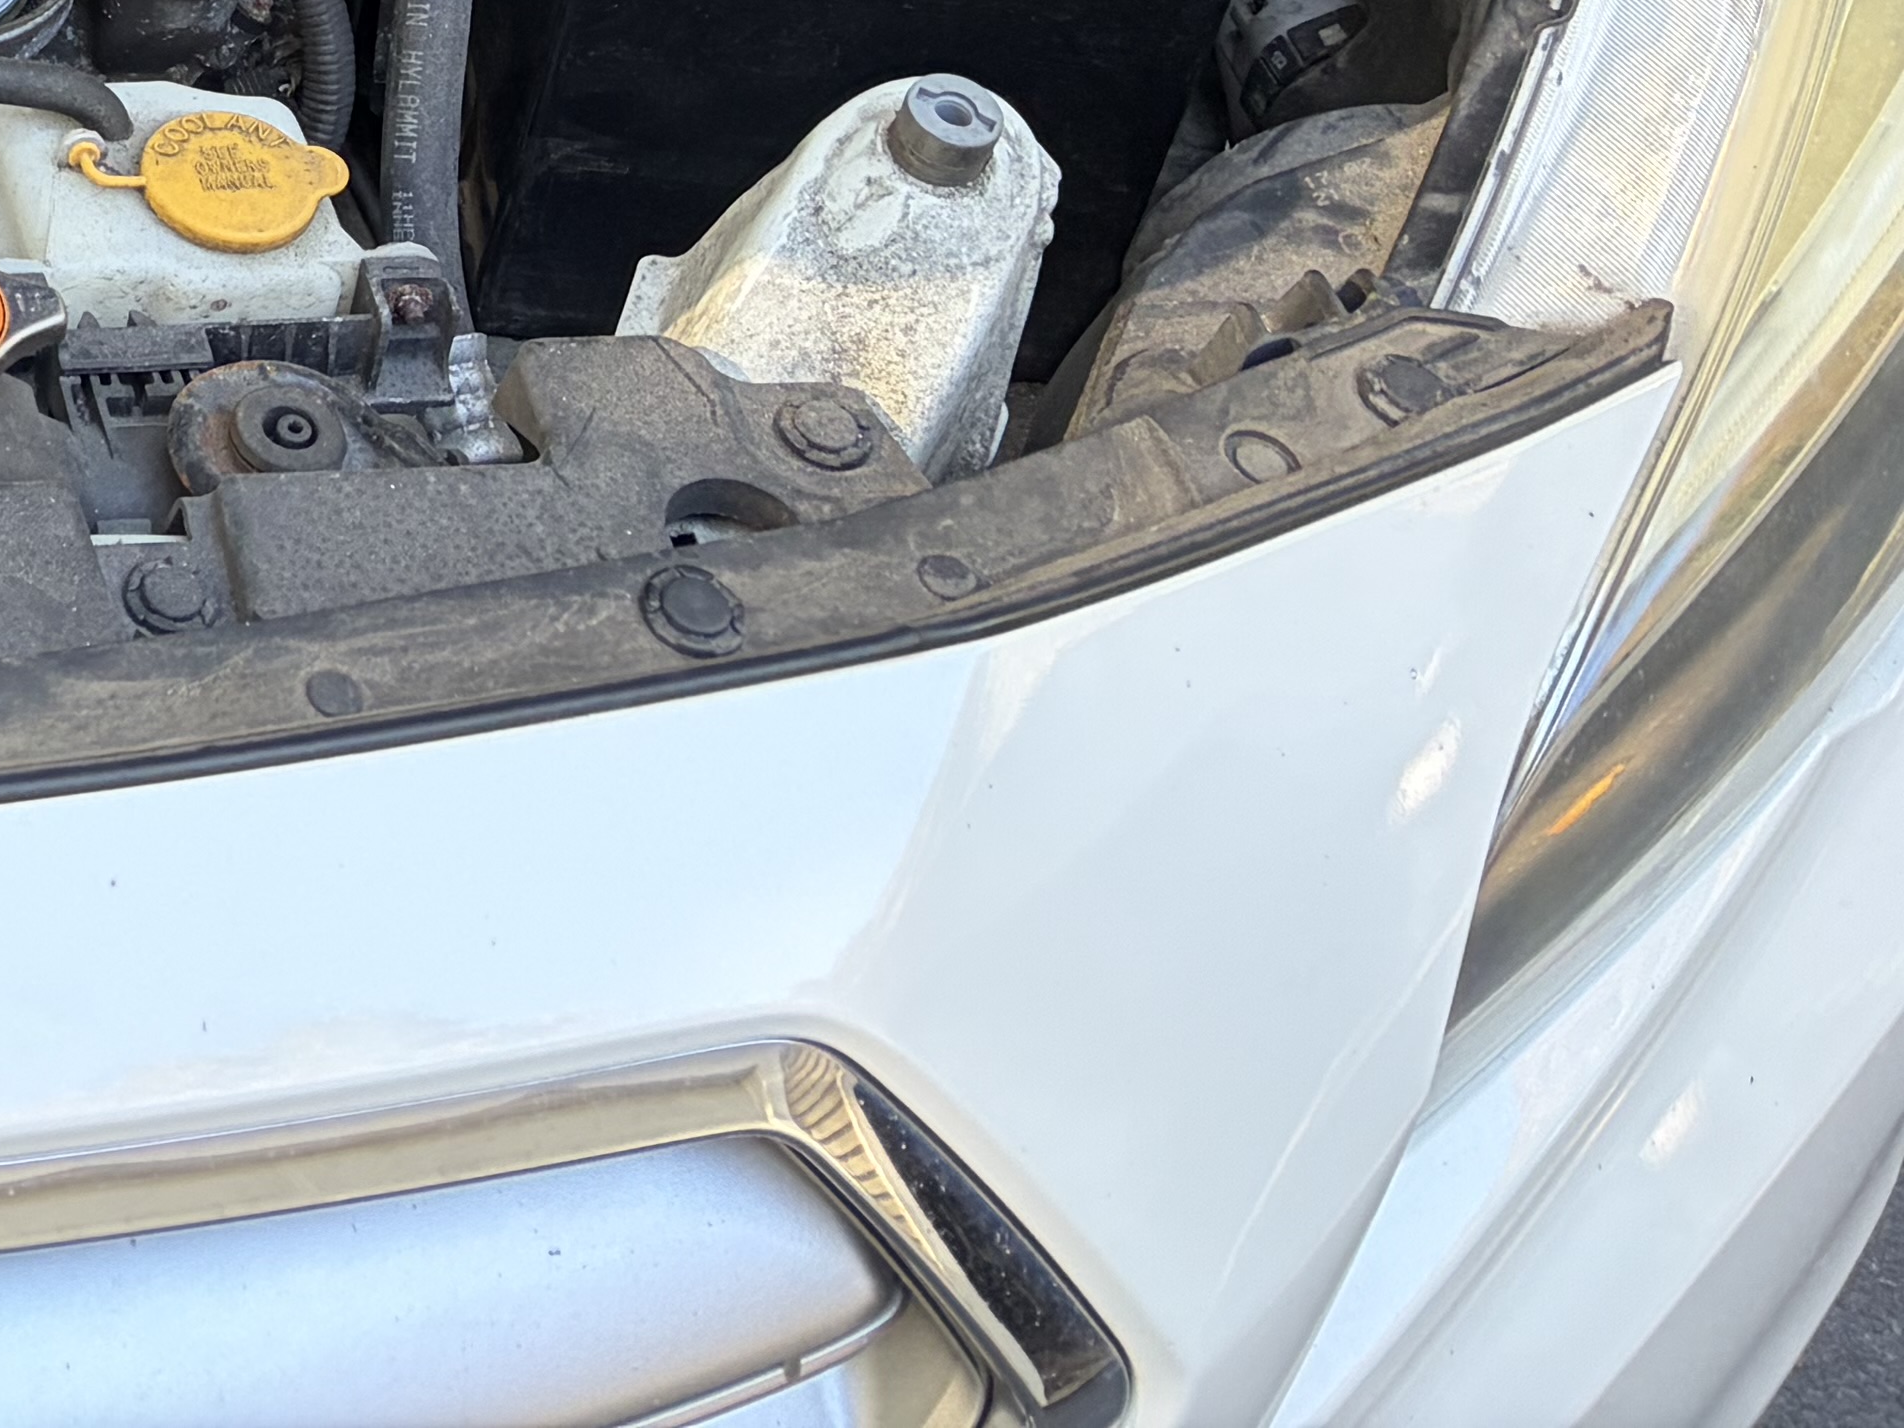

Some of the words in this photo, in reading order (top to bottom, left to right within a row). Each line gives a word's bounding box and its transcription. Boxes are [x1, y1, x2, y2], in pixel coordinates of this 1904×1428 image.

[393, 51, 425, 164] HYLAMMIT
[154, 112, 291, 157] COOLANT
[200, 143, 239, 160] SEE
[198, 174, 276, 192] MANUAL
[392, 190, 404, 241] INNE
